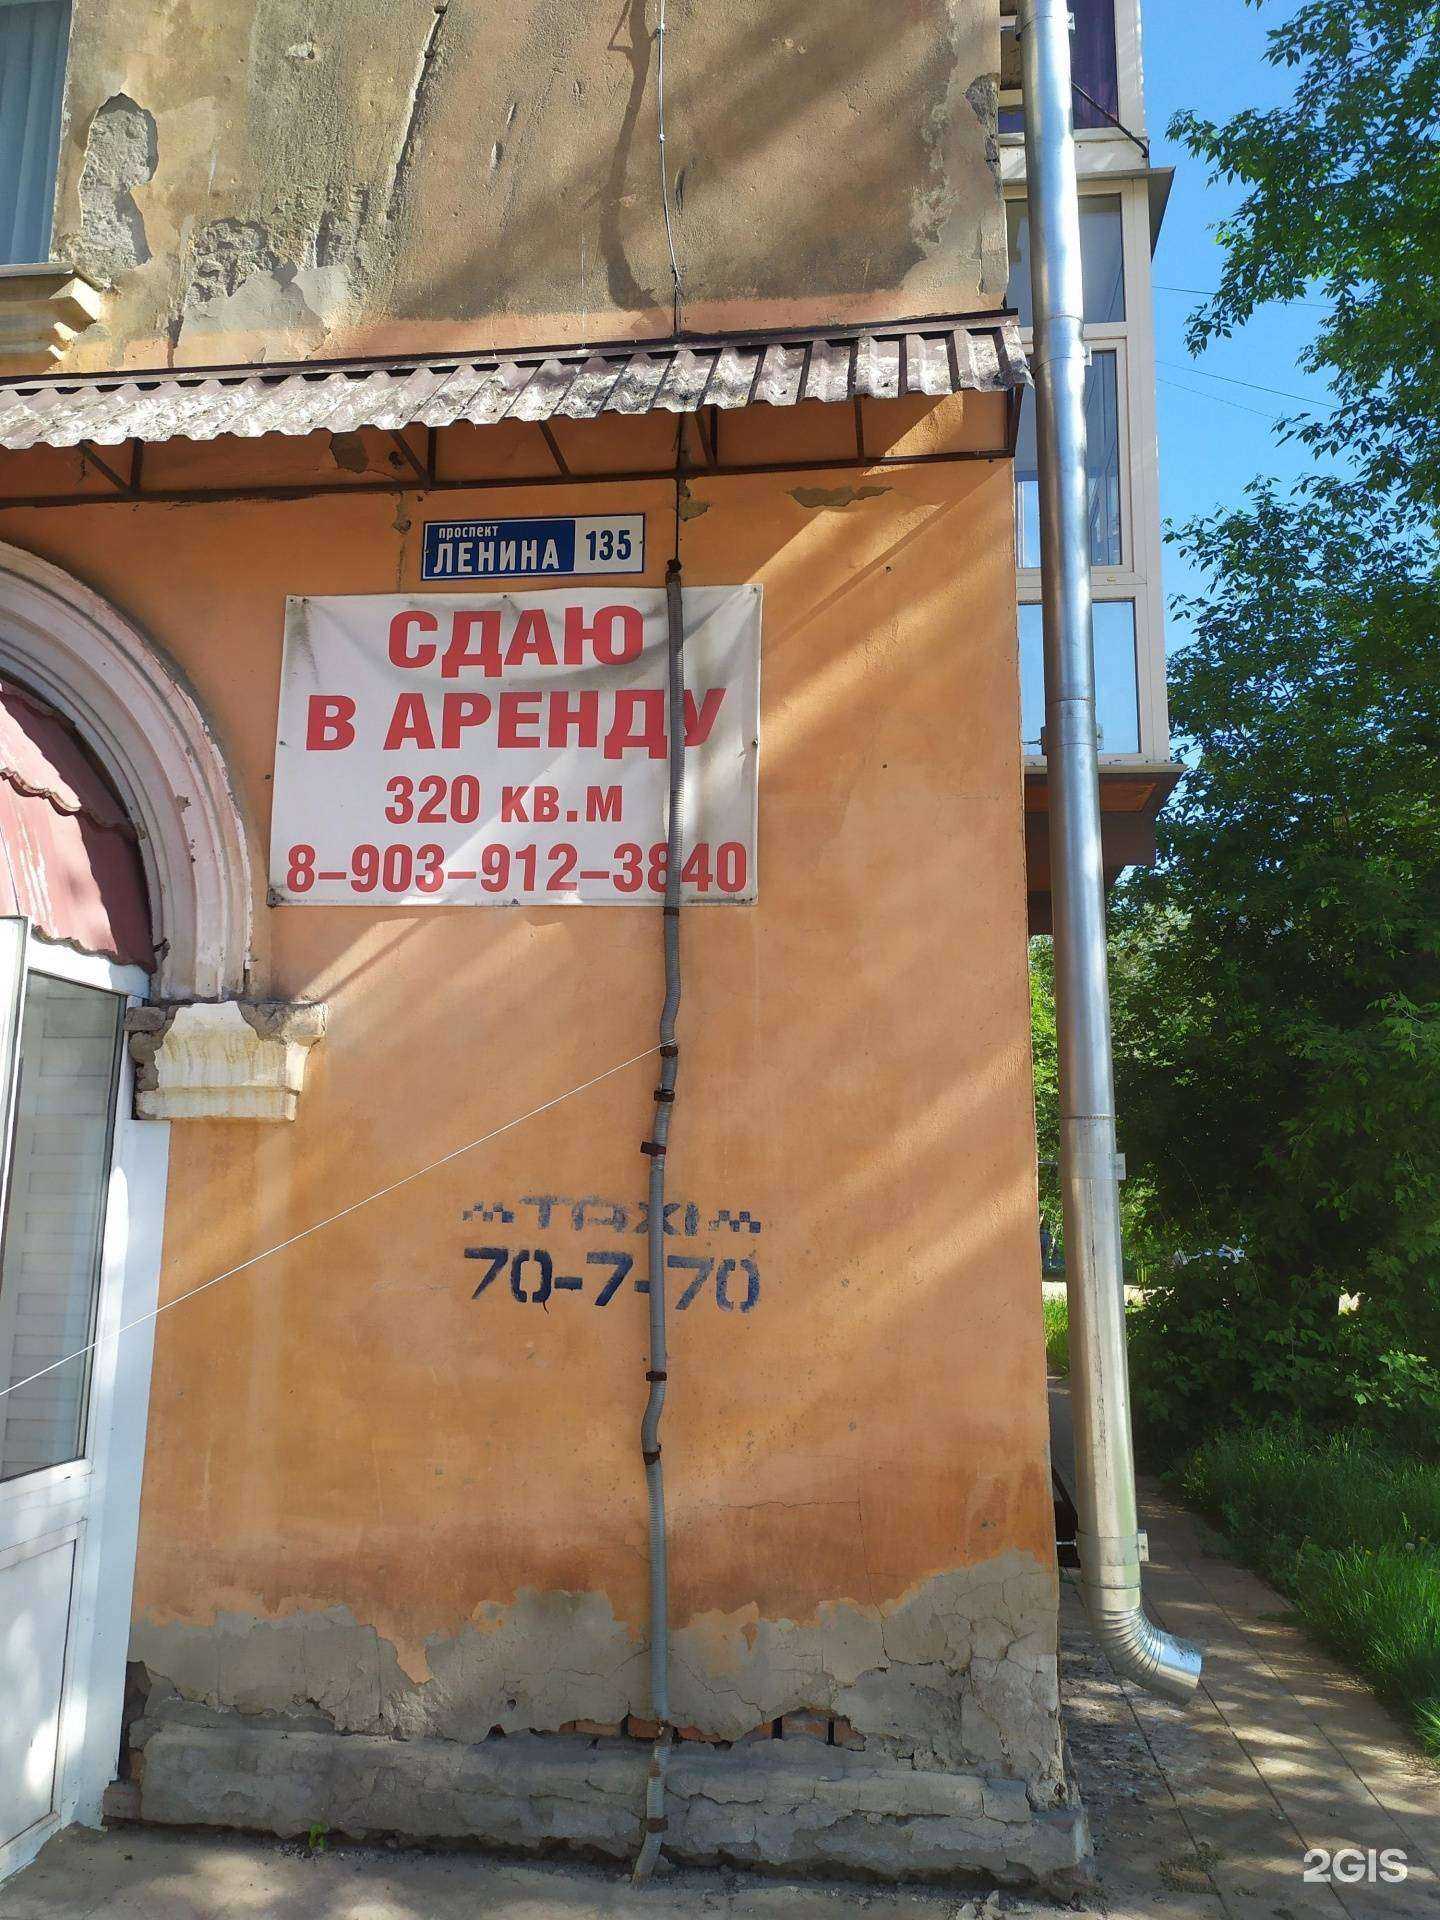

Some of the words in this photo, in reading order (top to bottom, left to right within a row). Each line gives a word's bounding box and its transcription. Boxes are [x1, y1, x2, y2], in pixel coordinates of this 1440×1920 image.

[433, 538, 560, 574] ЛЕНИНА
[438, 525, 499, 541] проспект
[585, 529, 632, 561] 135
[387, 605, 644, 678] СДАЮ
[305, 694, 357, 751] В
[382, 687, 727, 760] АРЕНДУ
[384, 774, 481, 824] 320
[286, 841, 747, 893] 8-903-912-3840
